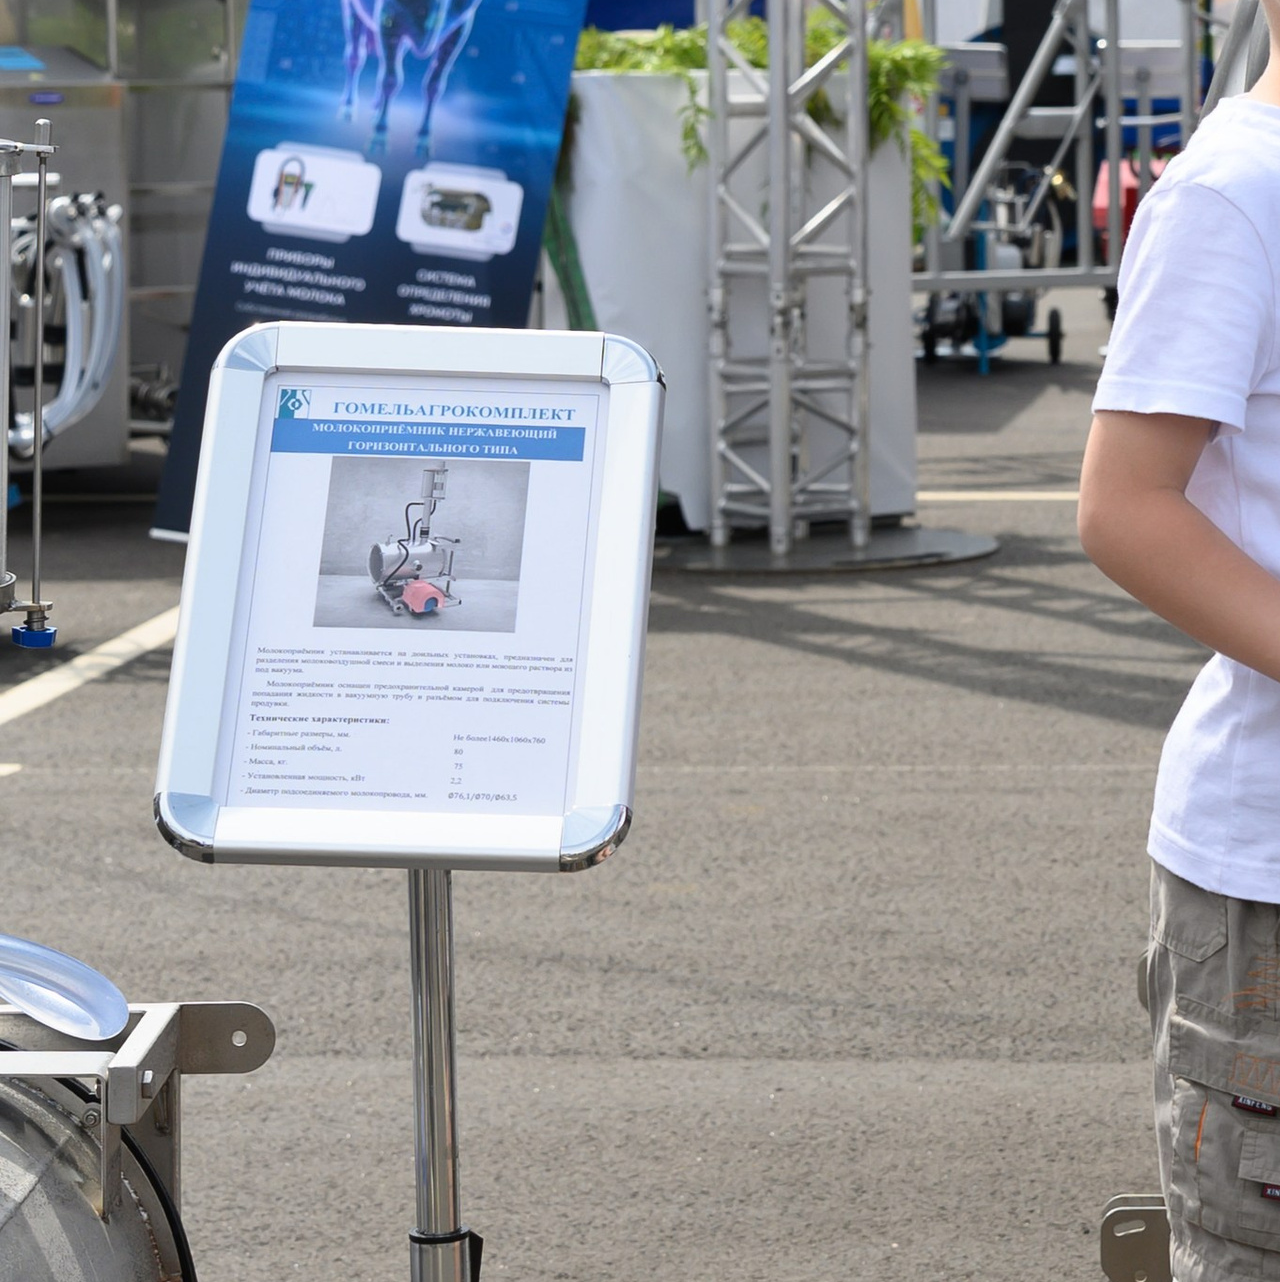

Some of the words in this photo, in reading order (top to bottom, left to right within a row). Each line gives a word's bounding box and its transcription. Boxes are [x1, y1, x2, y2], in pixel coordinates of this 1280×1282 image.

[266, 247, 335, 268] ПРИБОРЫ
[416, 268, 476, 288] СИСТЕМА
[333, 401, 576, 421] ГОМЕЛЬАГРОКОМПЛЕКТ
[312, 422, 446, 437] МОЛОКОПРИЁМНИК
[449, 426, 558, 440] НЕРЖАВЕЮЩИЙ
[348, 440, 480, 454] ГОРИЗОНТАЛЬНОГО
[482, 445, 518, 456] ТИПА
[250, 714, 309, 723] Технические
[310, 717, 390, 725] характеристики:
